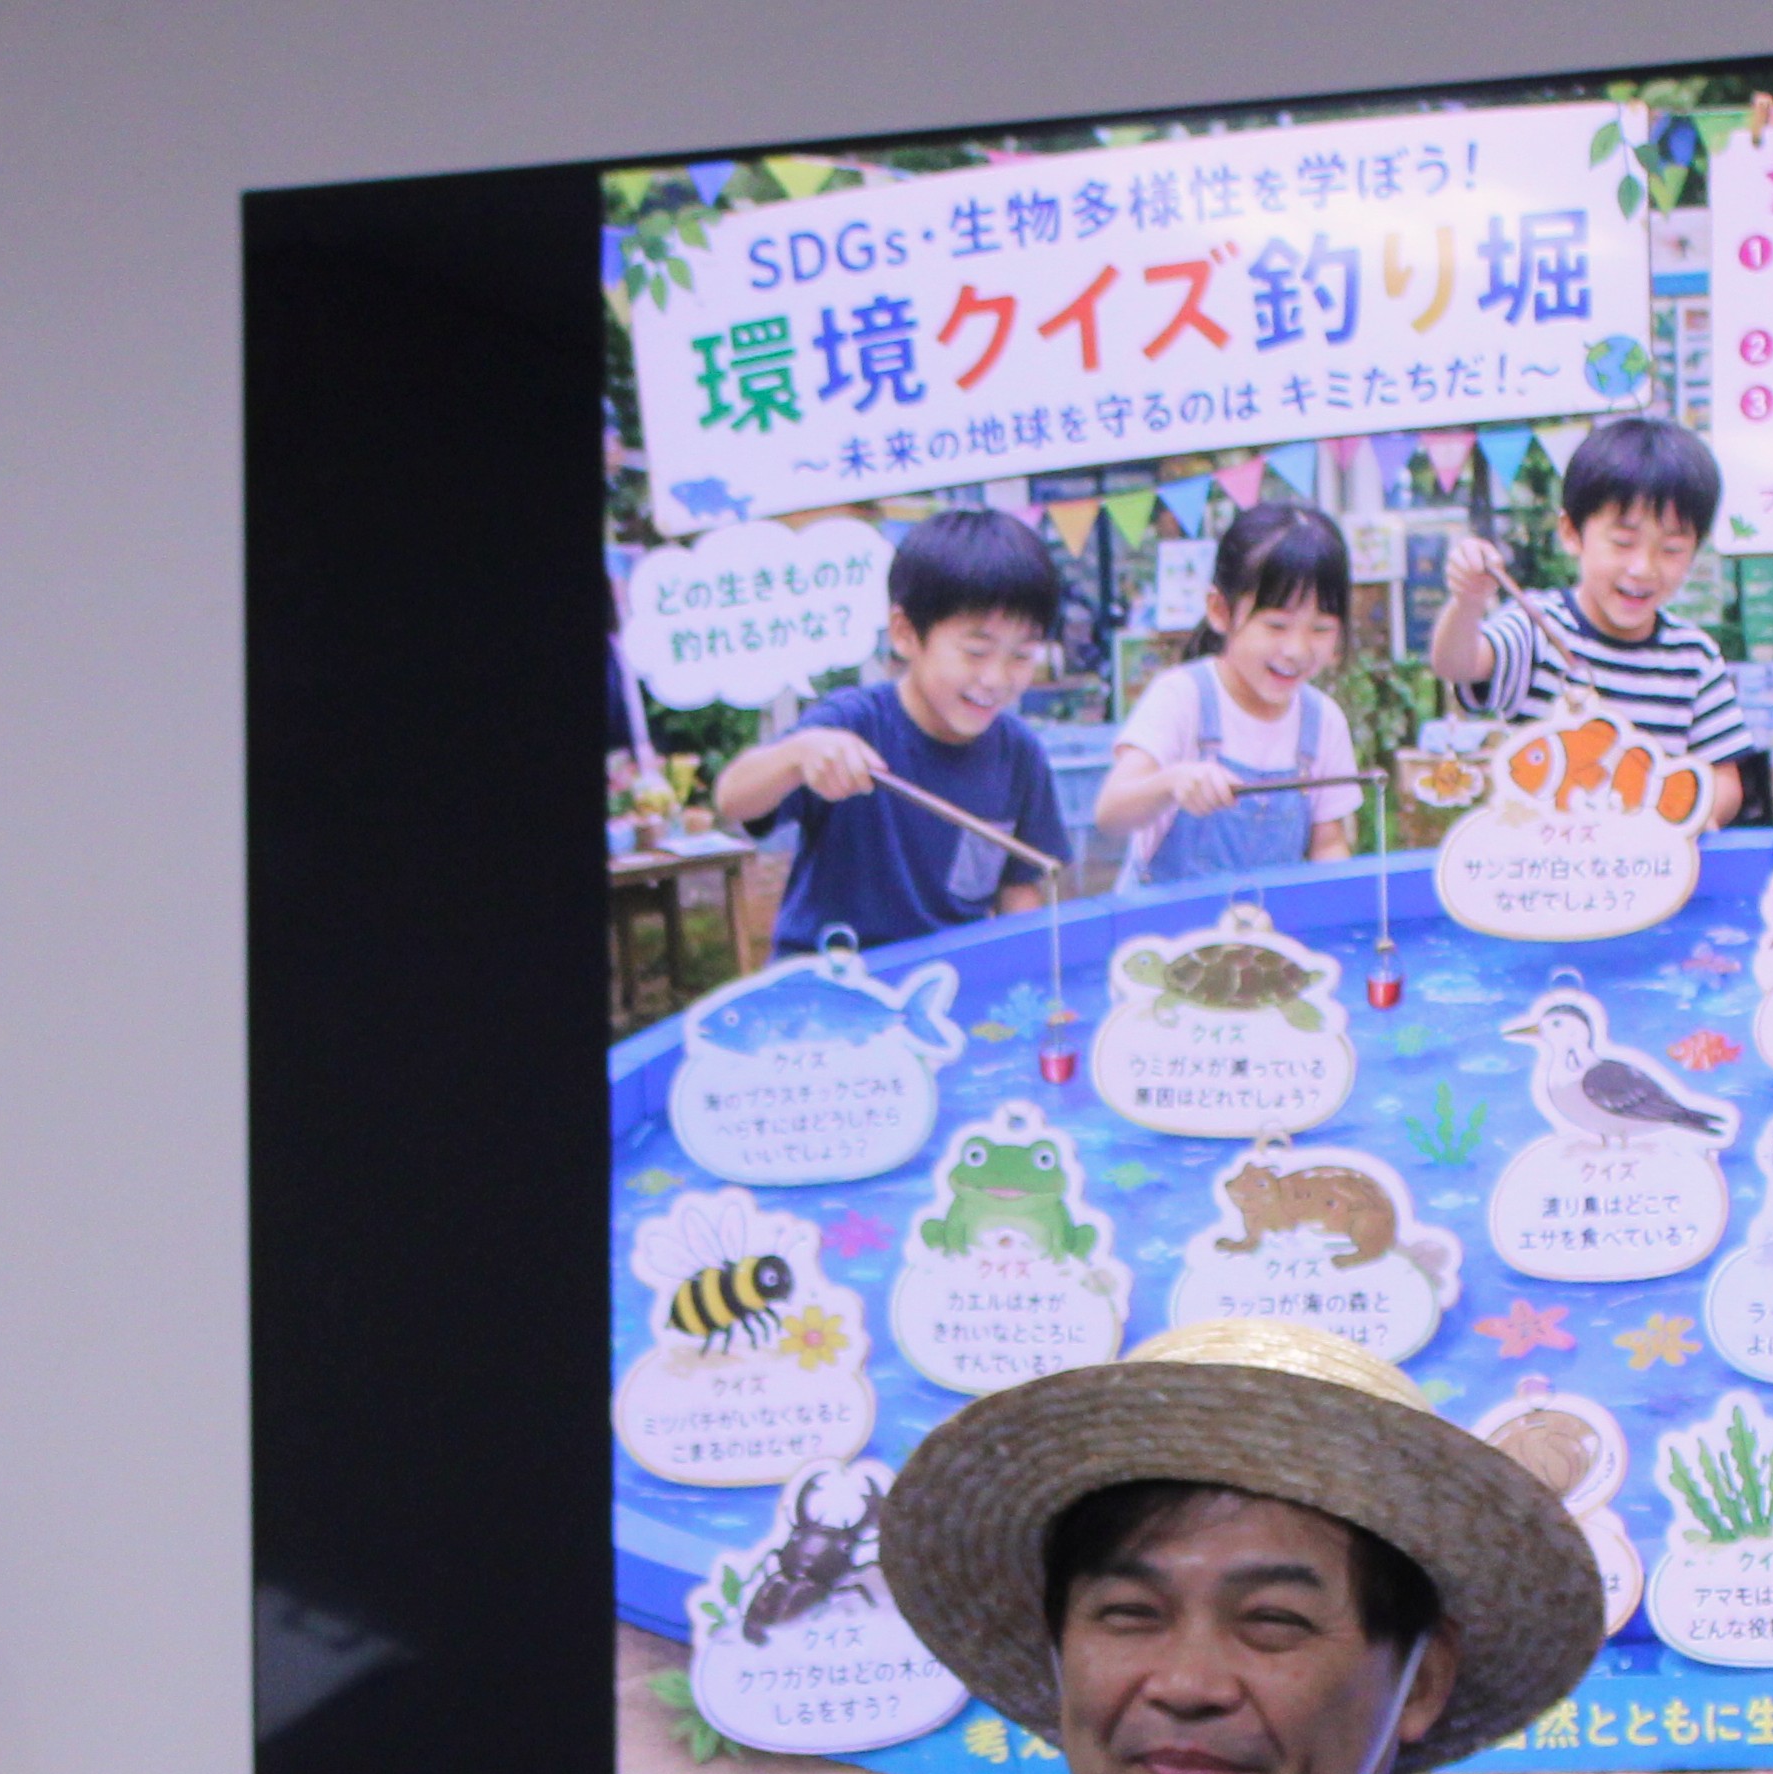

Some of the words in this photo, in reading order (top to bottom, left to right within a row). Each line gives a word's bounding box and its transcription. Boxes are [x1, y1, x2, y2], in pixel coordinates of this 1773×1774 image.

[747, 141, 1482, 291] SDGs・生物多様性を学ぼう！
[689, 208, 1592, 435] 環境クイズ釣り堀
[657, 551, 873, 616] どの生きものが
[671, 603, 852, 663] 釣れるかな？
[1539, 822, 1602, 845] クイズ
[1463, 856, 1673, 880] サンゴが白くなるのは
[1495, 889, 1636, 912] なぜでしょう？
[1190, 1022, 1248, 1045] クイズ
[1580, 1159, 1640, 1183] クイズ
[978, 1259, 1031, 1280] クイズ
[1265, 1258, 1324, 1280] クイズ
[931, 1322, 1085, 1345] きれいなところに
[710, 1374, 768, 1397] クイズ
[802, 1624, 867, 1651] クイズ
[773, 1694, 901, 1727] しるをすう？
